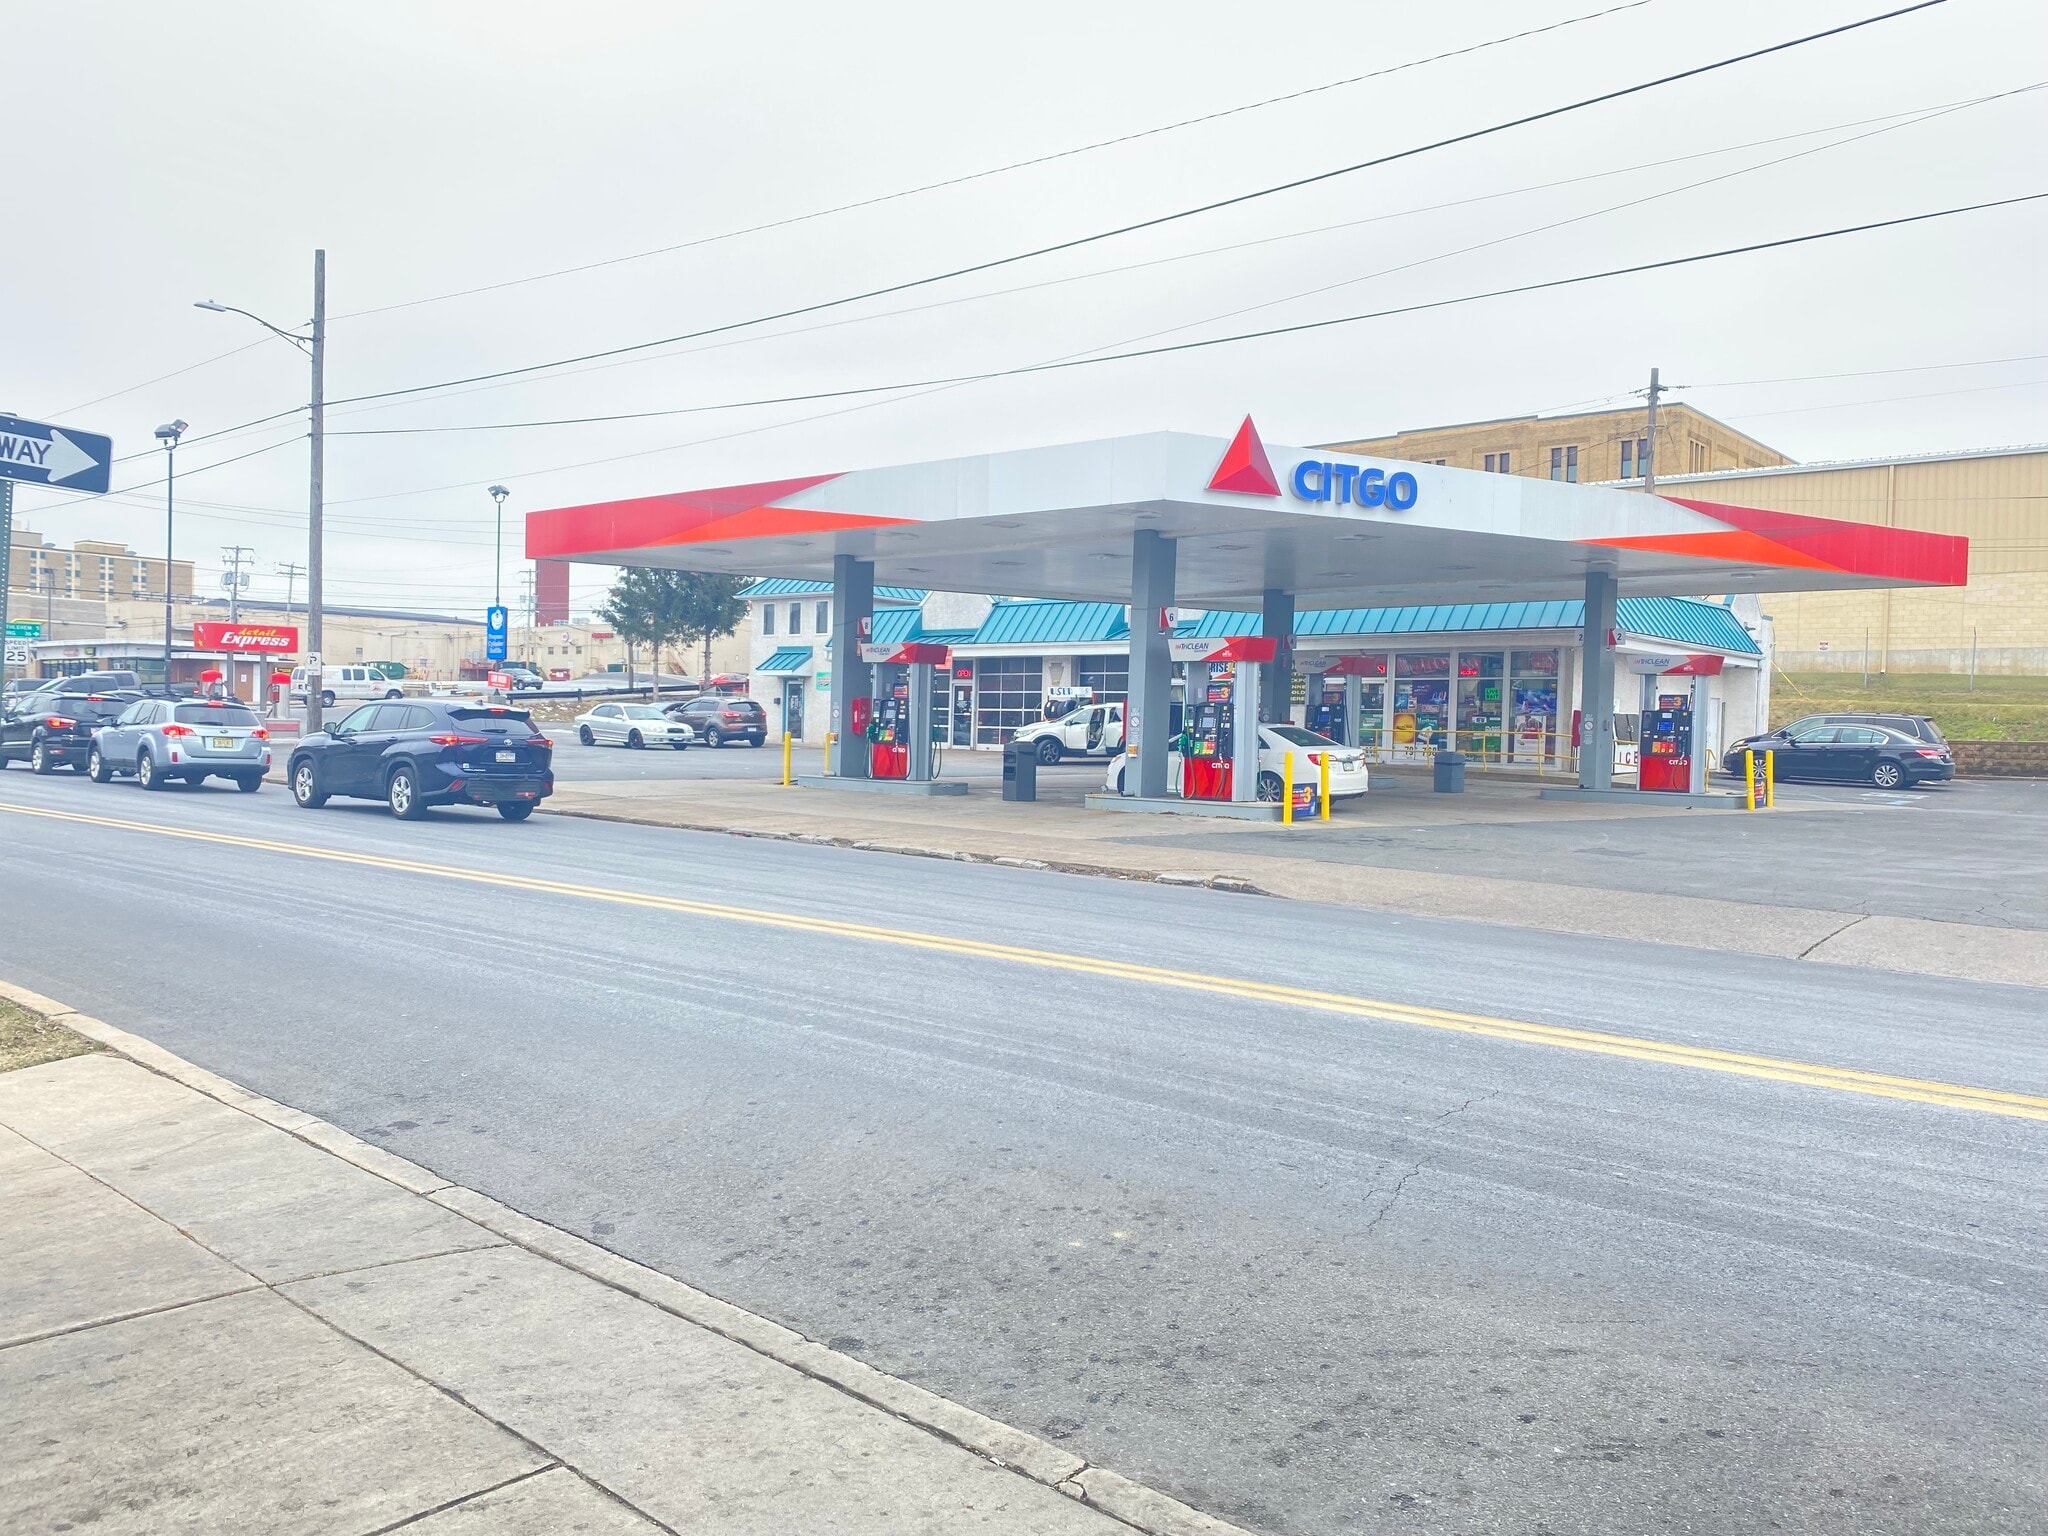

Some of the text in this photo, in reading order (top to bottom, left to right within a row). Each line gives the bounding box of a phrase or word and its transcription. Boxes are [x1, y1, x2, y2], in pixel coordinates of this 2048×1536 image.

[0, 436, 52, 464] WAY
[1290, 460, 1418, 511] CITGO
[1169, 613, 1174, 621] 6
[239, 627, 277, 636] detail
[221, 631, 290, 648] Express
[6, 651, 27, 661] 25
[1209, 662, 1228, 672] RISE
[1220, 687, 1229, 698] 3
[1673, 696, 1682, 706] 3
[1619, 751, 1638, 764] ICE
[1303, 786, 1311, 803] 3
